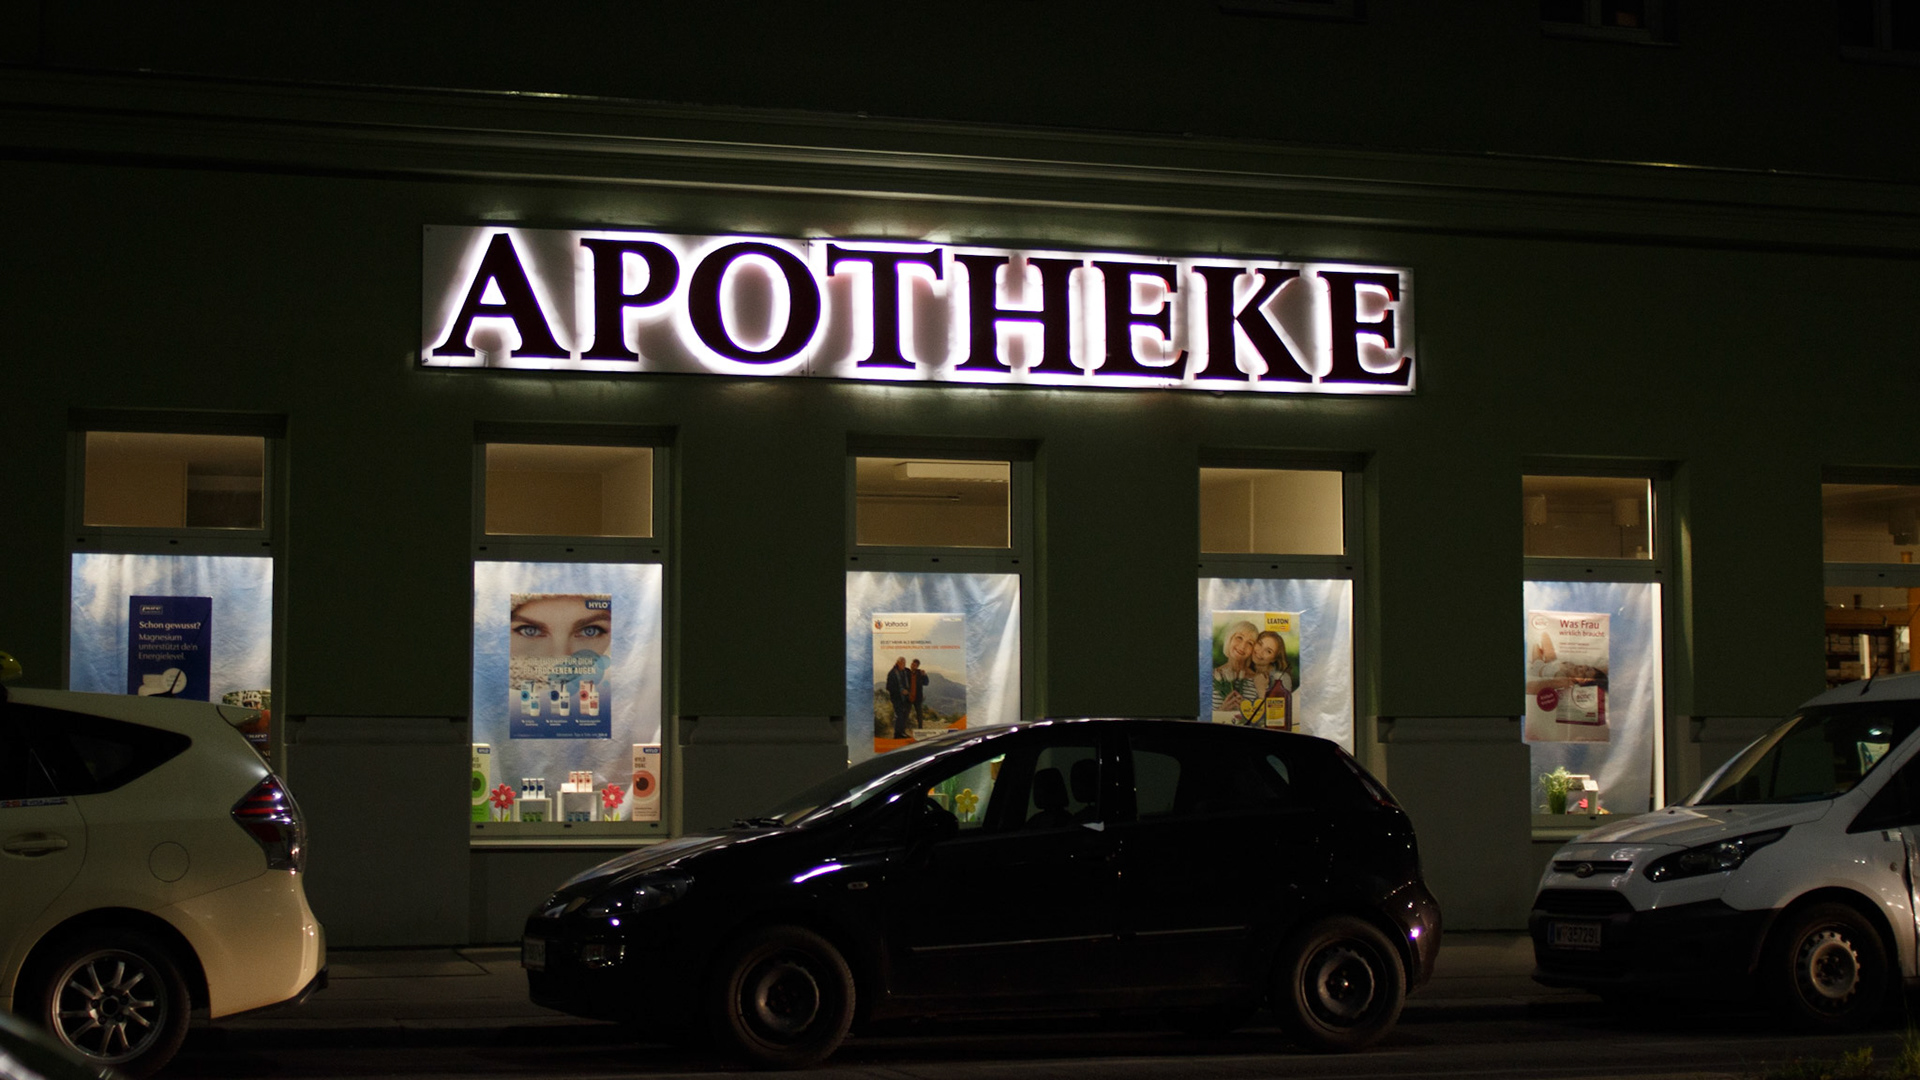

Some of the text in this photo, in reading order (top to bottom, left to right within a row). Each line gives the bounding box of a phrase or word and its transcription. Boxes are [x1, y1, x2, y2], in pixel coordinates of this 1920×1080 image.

[431, 232, 1412, 387] APOTHEKE
[139, 620, 201, 631] Schon gewusst?
[1560, 619, 1600, 629] Was Frau
[139, 633, 182, 642] Magnesium
[1559, 629, 1582, 637] wirklich
[139, 643, 198, 651] unterstützt dein
